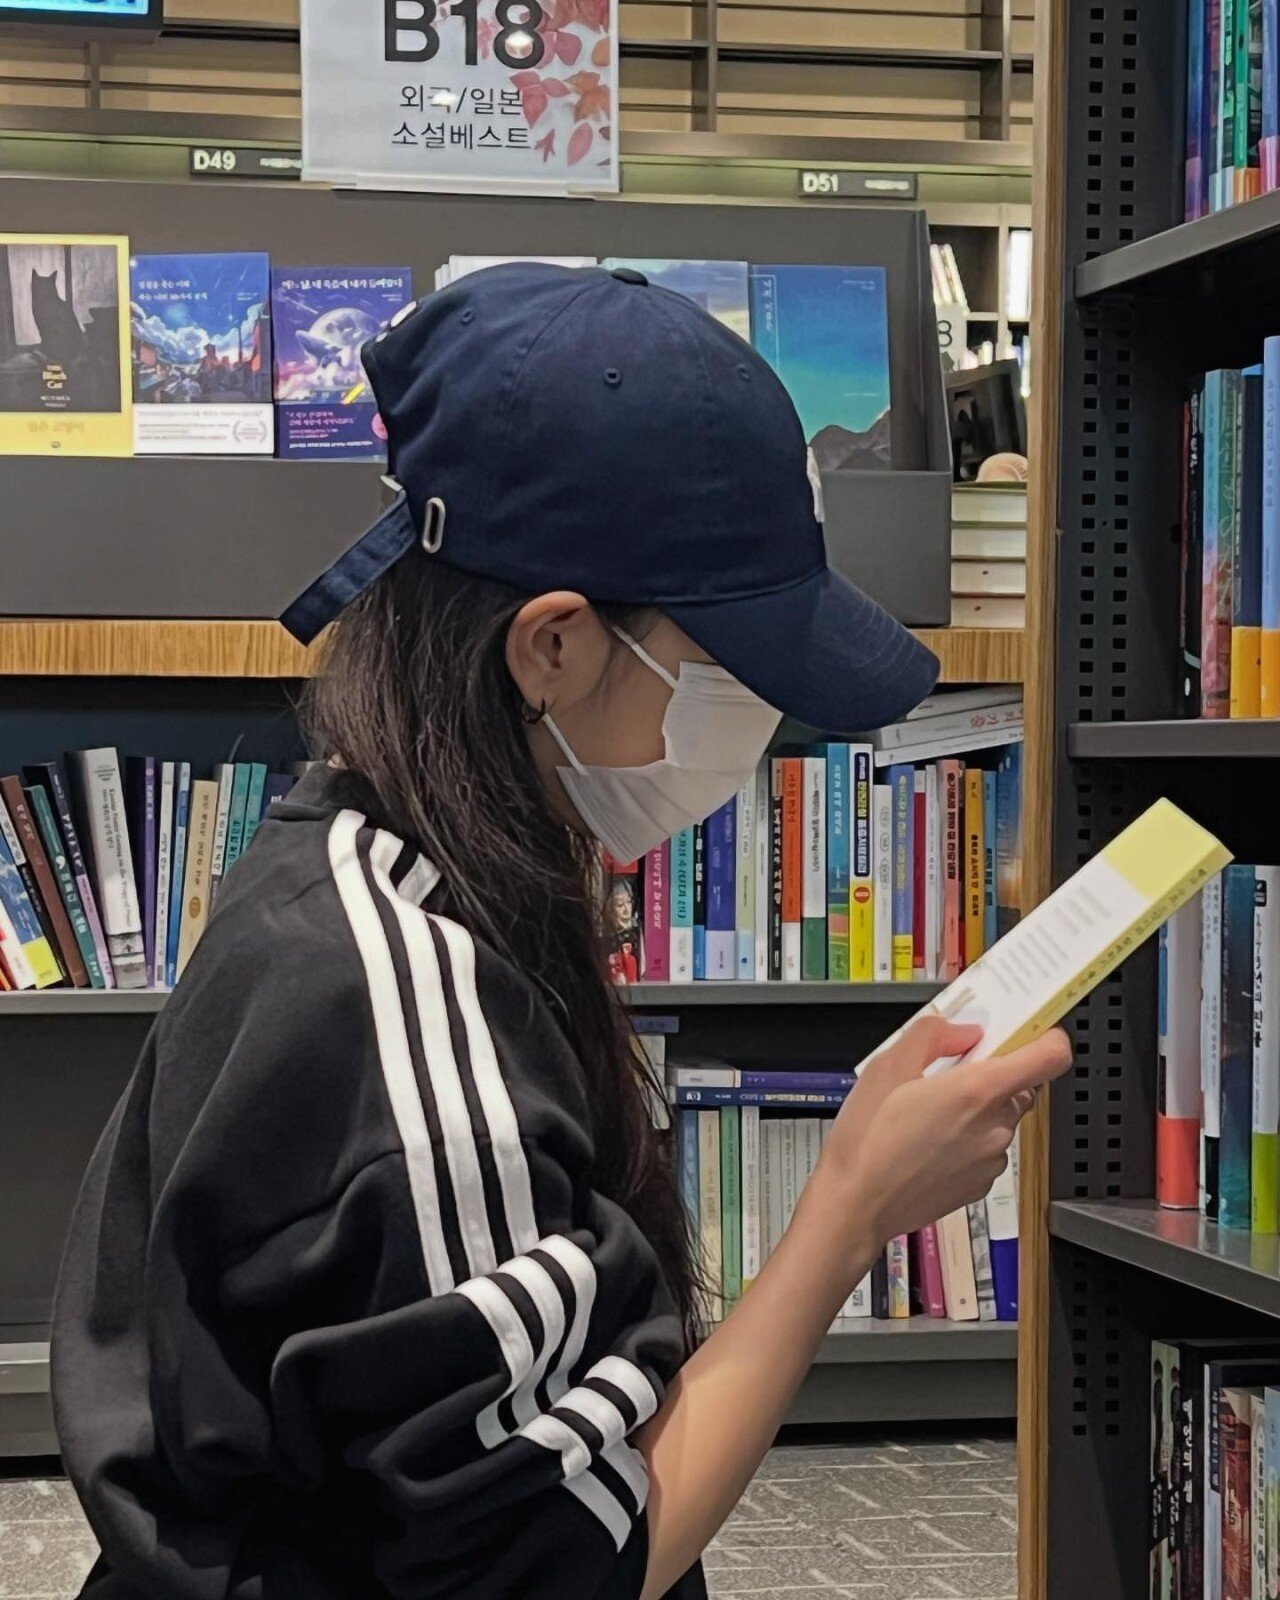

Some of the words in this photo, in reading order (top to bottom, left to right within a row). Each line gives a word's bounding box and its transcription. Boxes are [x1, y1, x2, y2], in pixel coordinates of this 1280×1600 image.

[384, 0, 545, 69] B18
[391, 121, 532, 150] 소설베스트
[193, 149, 236, 171] D49
[802, 171, 839, 192] D51
